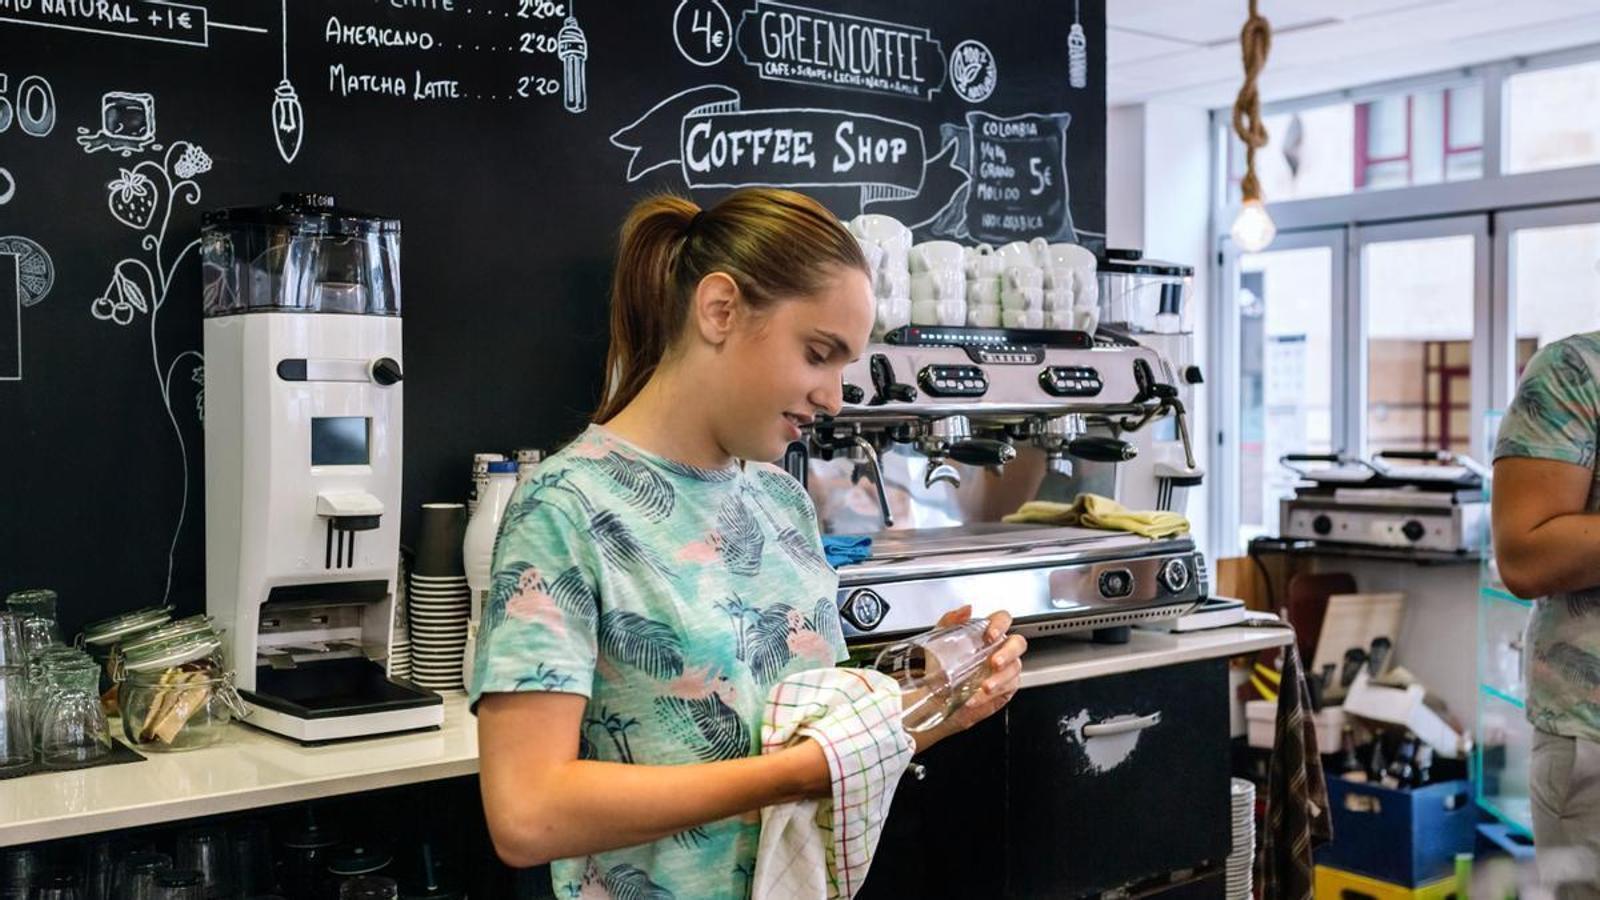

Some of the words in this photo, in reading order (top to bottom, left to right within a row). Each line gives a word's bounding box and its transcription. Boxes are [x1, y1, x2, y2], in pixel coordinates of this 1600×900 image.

[41, 0, 138, 23] NATURAL
[326, 16, 434, 50] AMERICANO
[520, 32, 558, 53] 2'20
[330, 63, 406, 97] MATCHA
[413, 70, 460, 100] LATTE
[517, 75, 560, 97] 2'20
[686, 119, 816, 173] COFFEE
[832, 121, 908, 173] SHOP
[982, 121, 1038, 138] COLOMBIA
